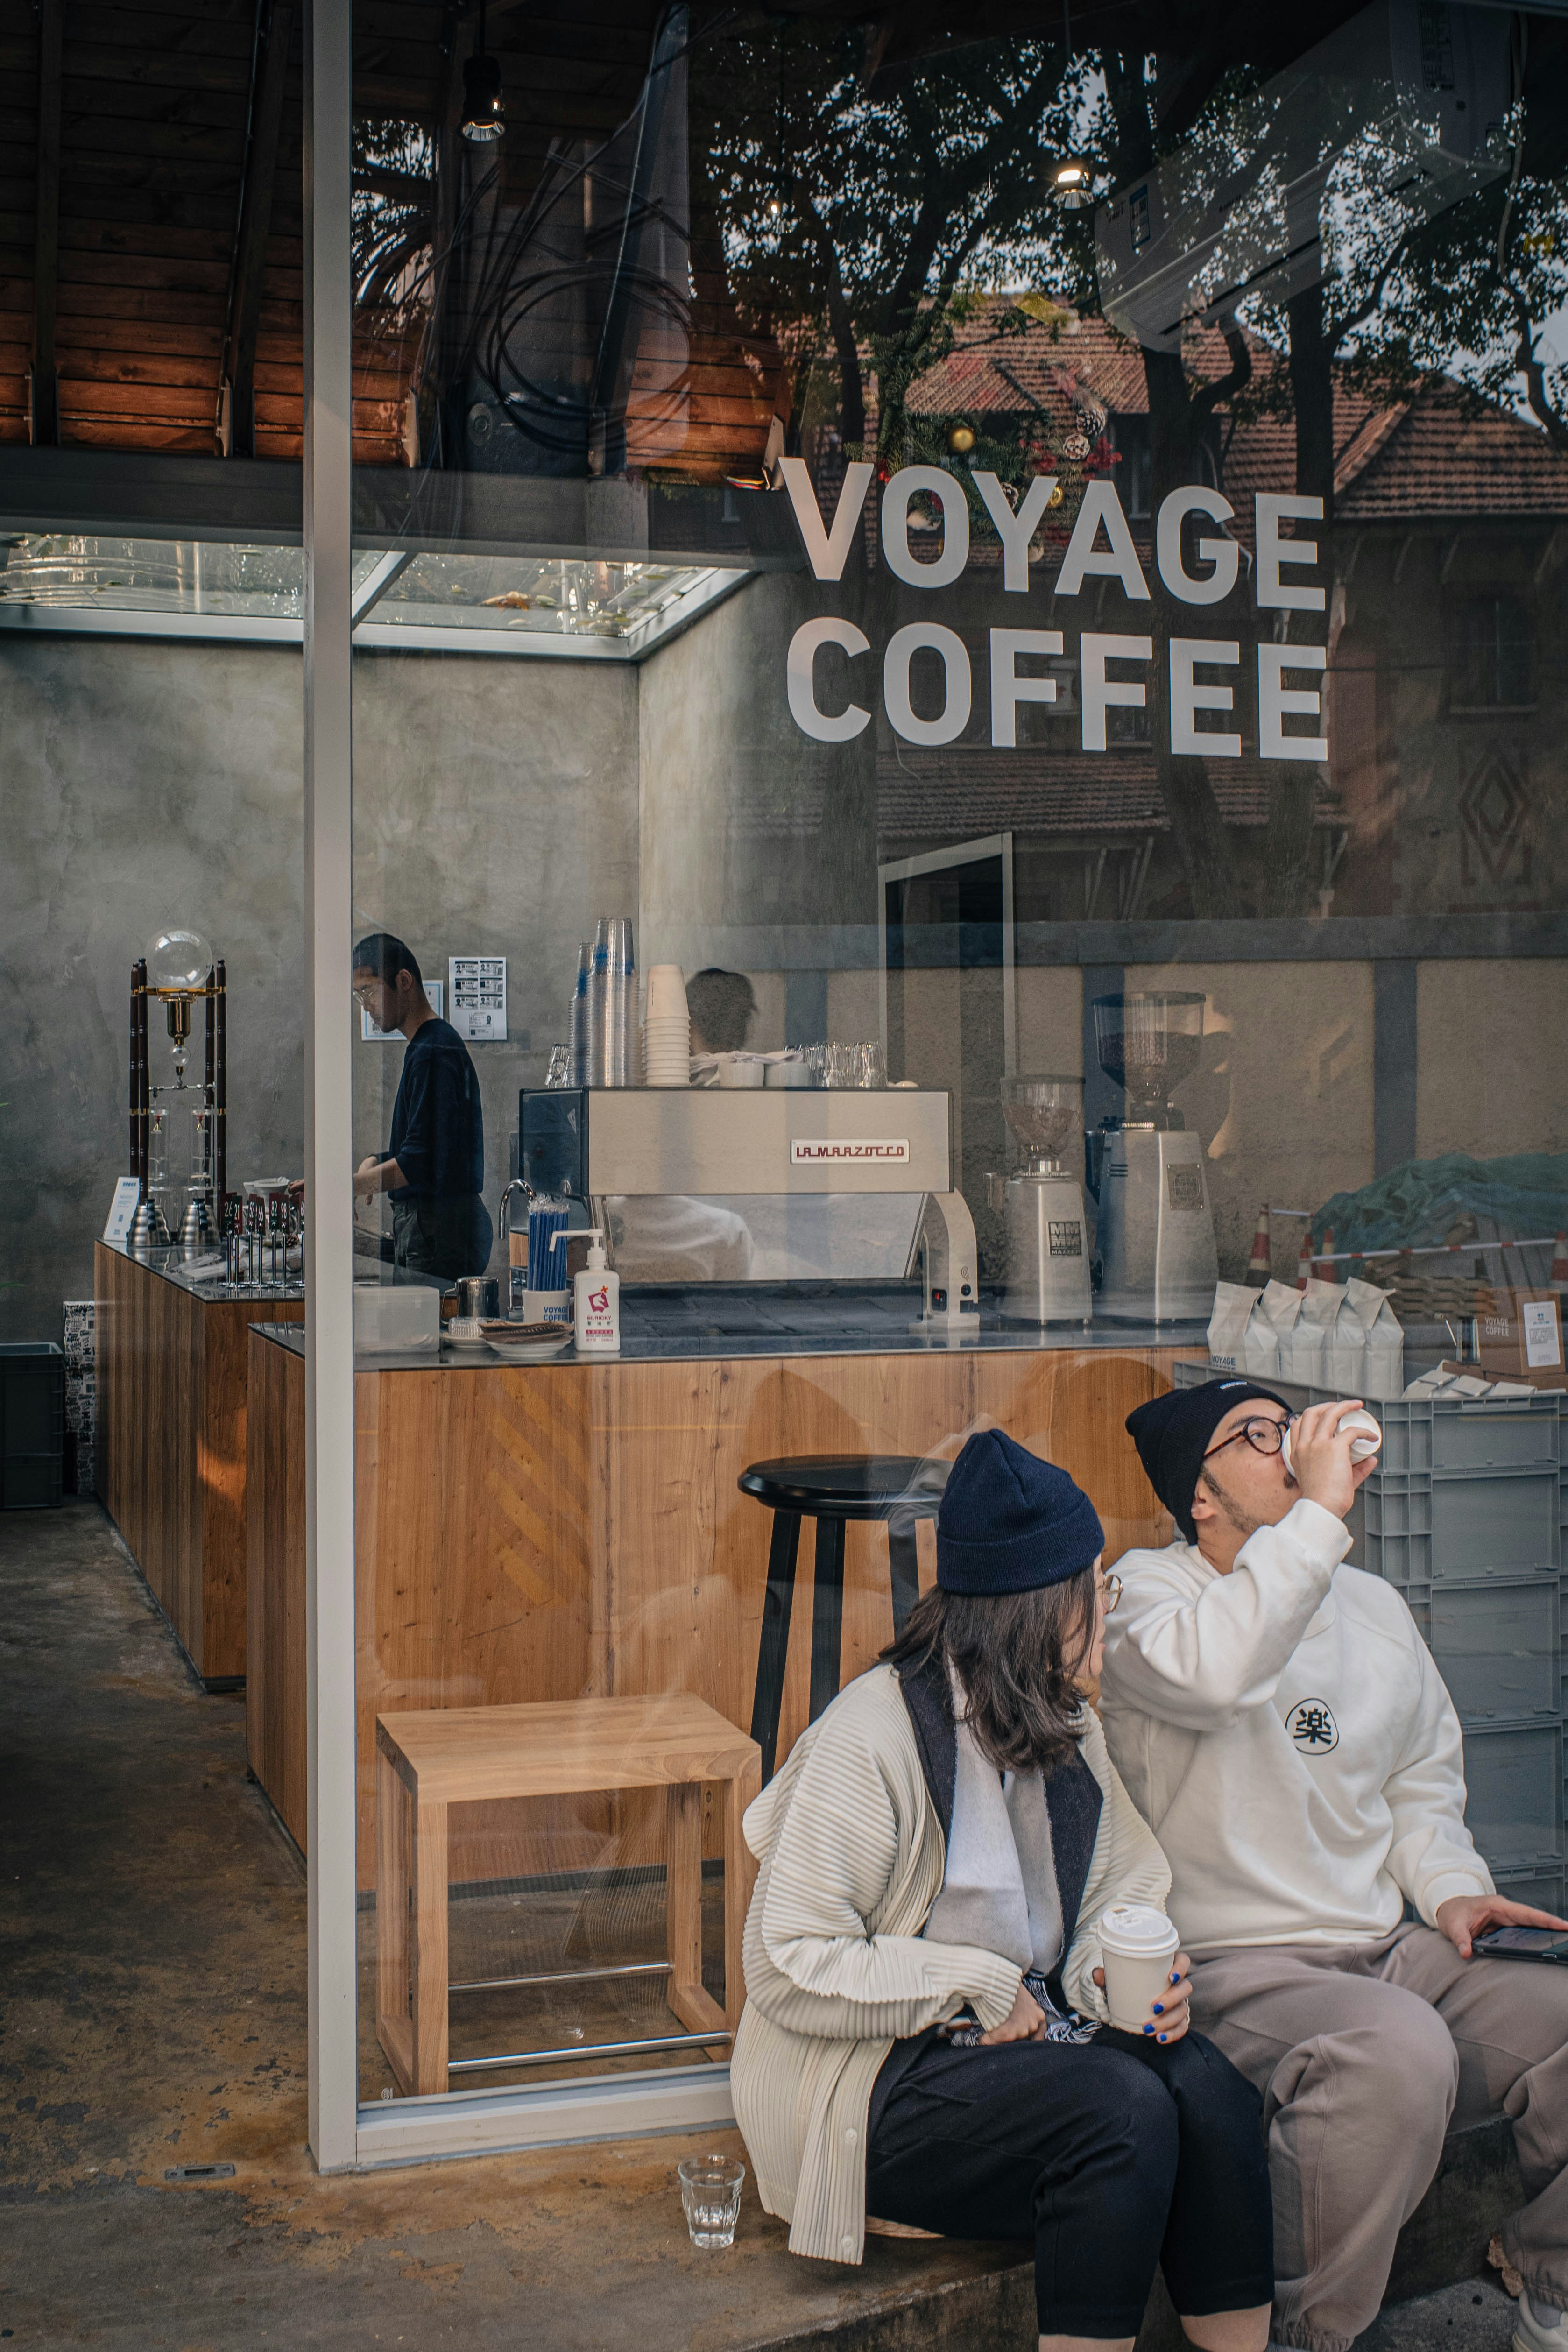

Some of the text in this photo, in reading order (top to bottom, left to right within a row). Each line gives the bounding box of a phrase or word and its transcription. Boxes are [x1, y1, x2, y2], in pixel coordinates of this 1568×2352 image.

[779, 457, 1326, 611] VOYAGE
[787, 617, 1328, 762] COFFEE
[797, 1147, 904, 1157] LA MARZOCCO
[234, 1204, 240, 1220] 21
[258, 1206, 264, 1222] 66
[271, 1201, 277, 1216] 82
[281, 1203, 287, 1219] 98
[1485, 1316, 1509, 1327] VOYAGE
[1485, 1327, 1510, 1336] COFFEE
[1212, 1355, 1236, 1366] VOYAGE
